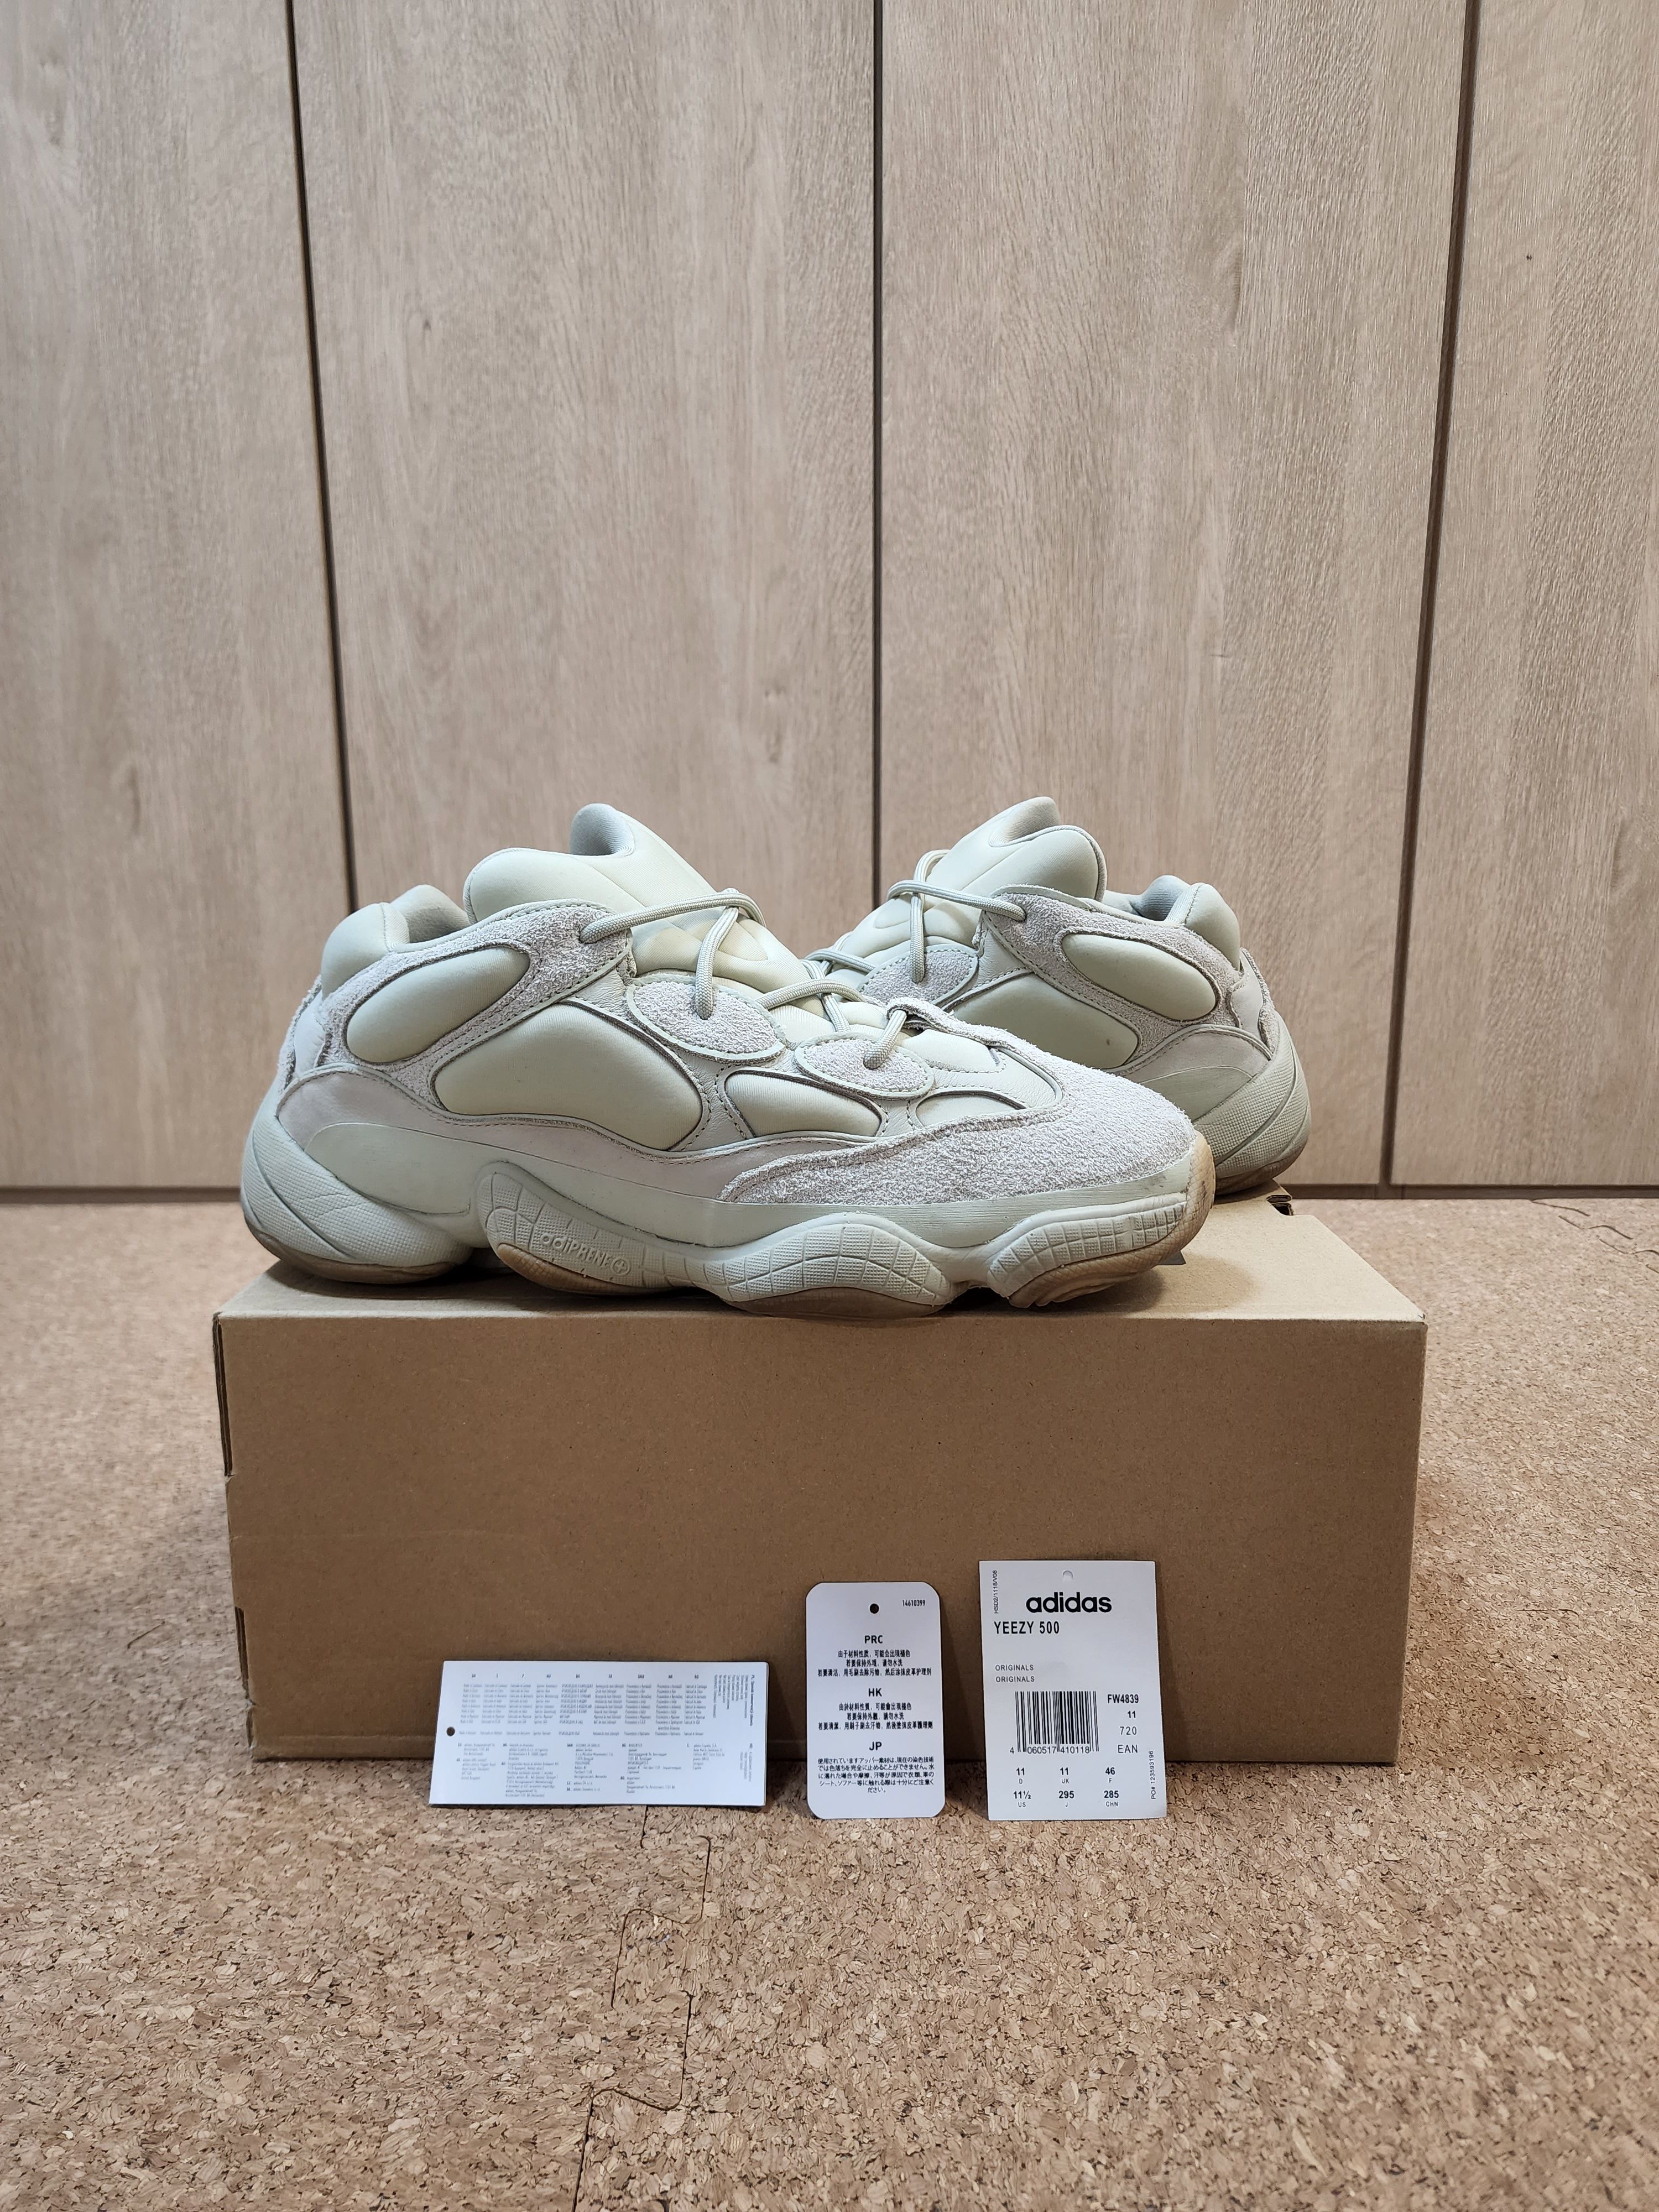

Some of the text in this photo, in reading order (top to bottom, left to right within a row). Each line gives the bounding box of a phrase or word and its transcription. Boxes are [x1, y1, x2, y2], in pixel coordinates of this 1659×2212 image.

[1026, 1592, 1112, 1613] adidas
[1039, 1620, 1060, 1634] 500
[864, 1635, 883, 1644] PRC
[868, 1687, 883, 1697] HK
[1107, 1693, 1139, 1704] FW4839
[1127, 1710, 1136, 1719] 11
[1119, 1726, 1137, 1735] 720
[869, 1741, 883, 1751] JP
[1118, 1744, 1138, 1754] EAN
[1016, 1767, 1025, 1776] 11
[1060, 1767, 1069, 1776] 11
[1105, 1766, 1115, 1775] 46
[1058, 1790, 1074, 1799] 295
[1103, 1790, 1119, 1799] 285
